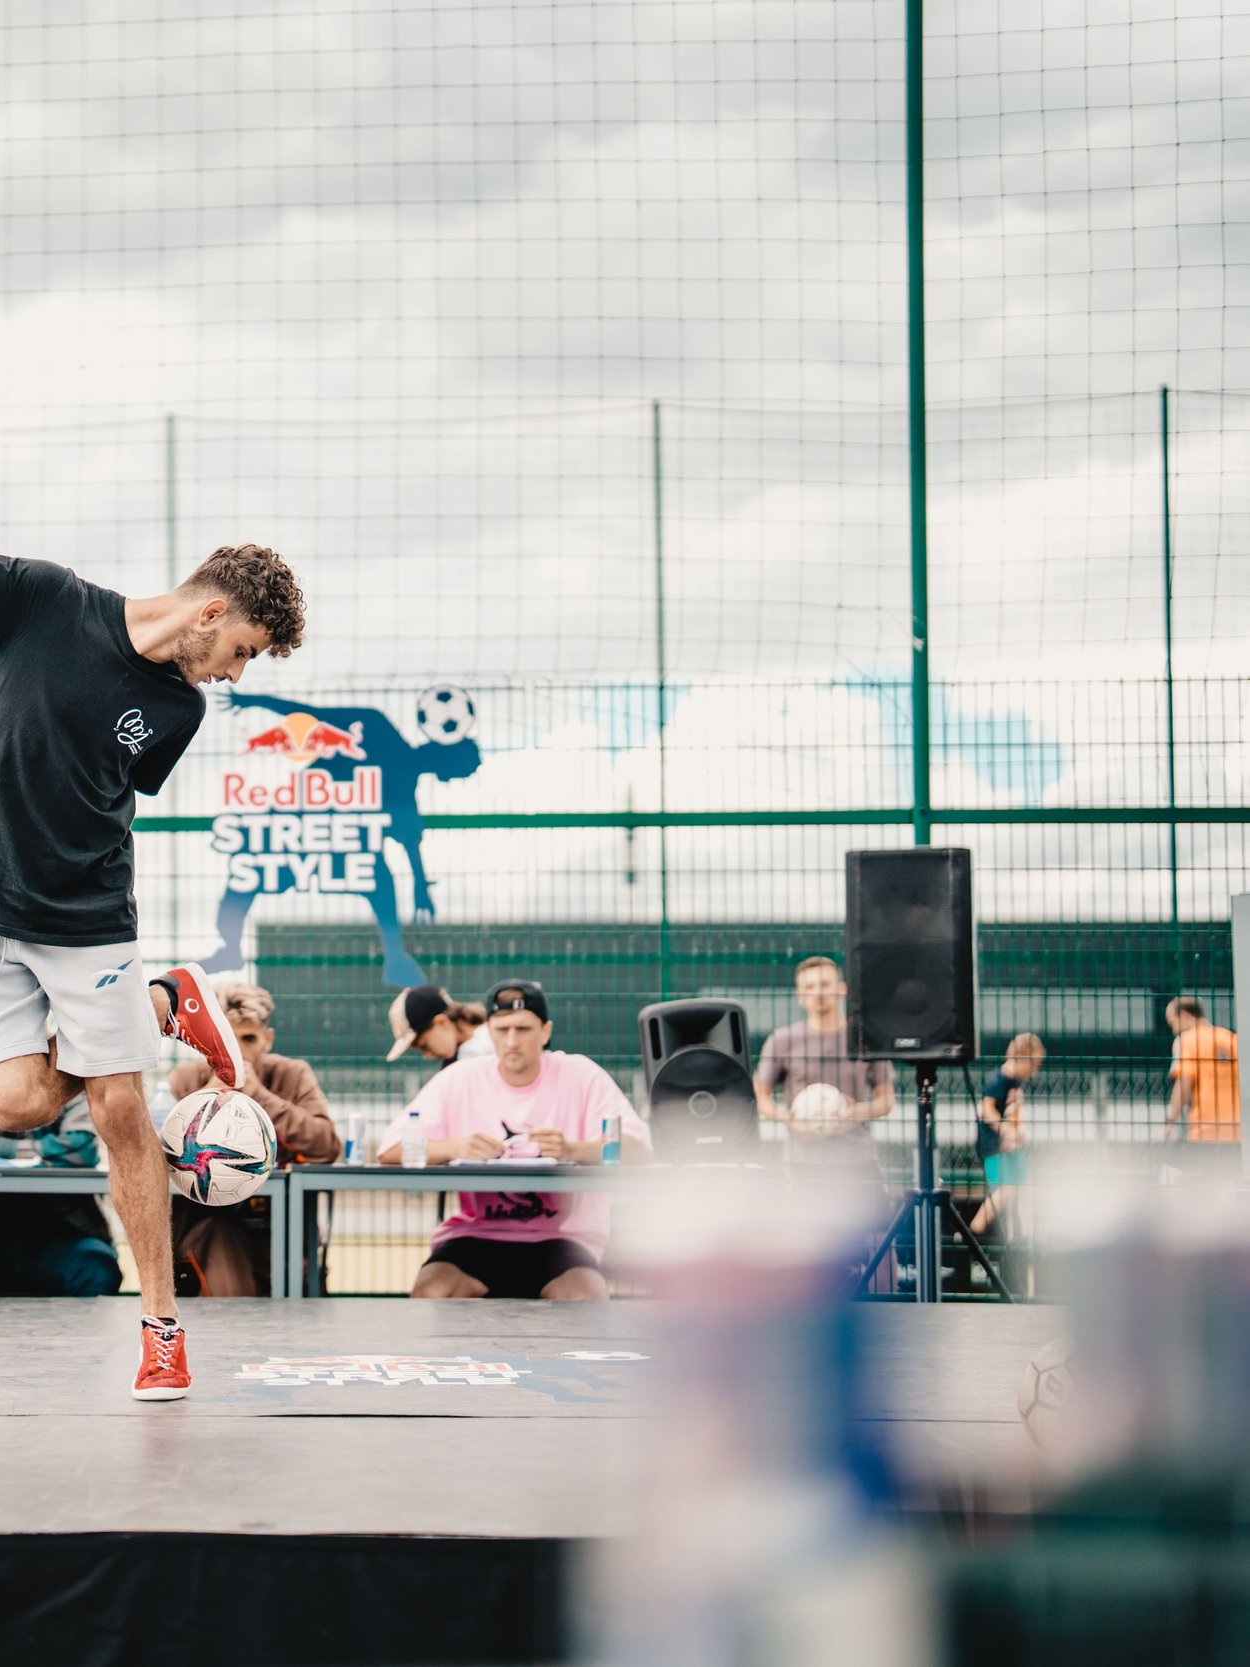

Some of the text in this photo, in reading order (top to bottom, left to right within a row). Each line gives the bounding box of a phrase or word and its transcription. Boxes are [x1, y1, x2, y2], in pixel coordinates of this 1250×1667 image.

[224, 771, 377, 806] Red Bull
[211, 813, 392, 853] STREET
[228, 853, 376, 892] STYLE
